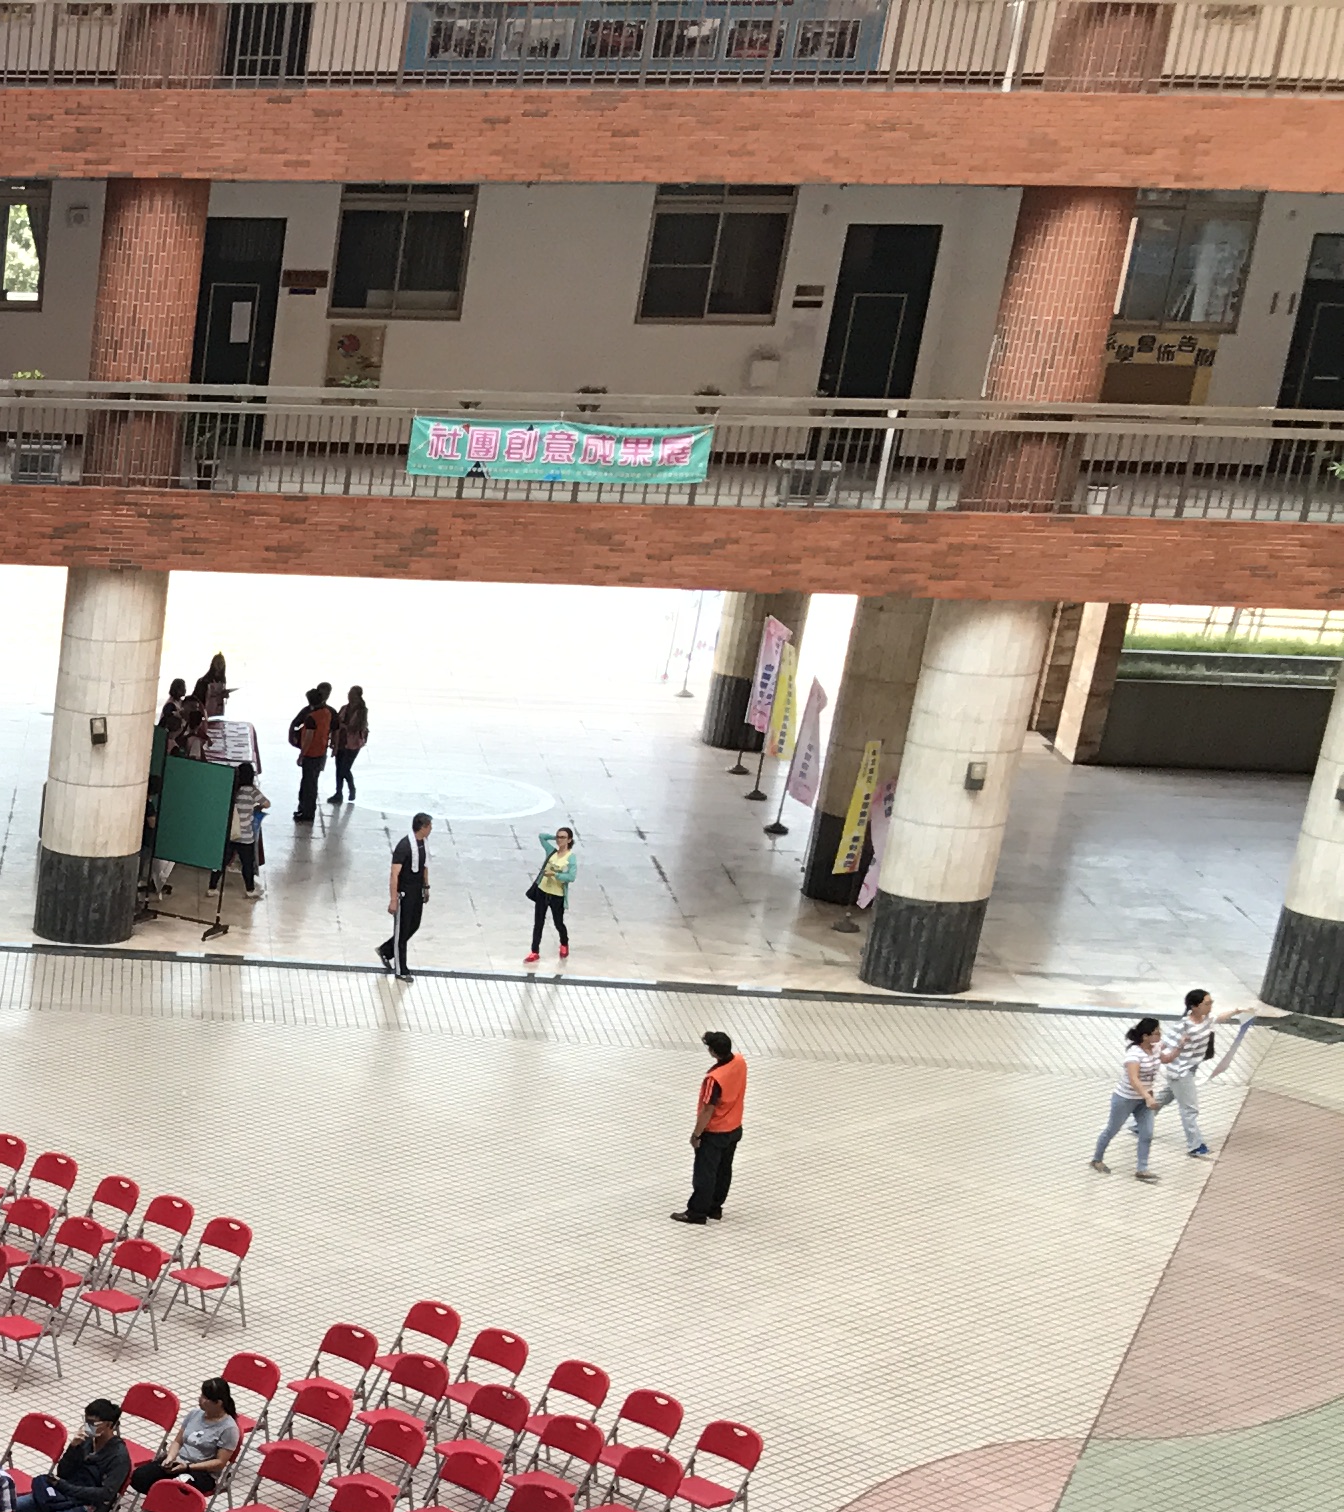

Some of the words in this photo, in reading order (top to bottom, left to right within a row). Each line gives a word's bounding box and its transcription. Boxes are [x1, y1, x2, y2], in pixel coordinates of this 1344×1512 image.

[427, 422, 694, 467] 社團創意成果展
